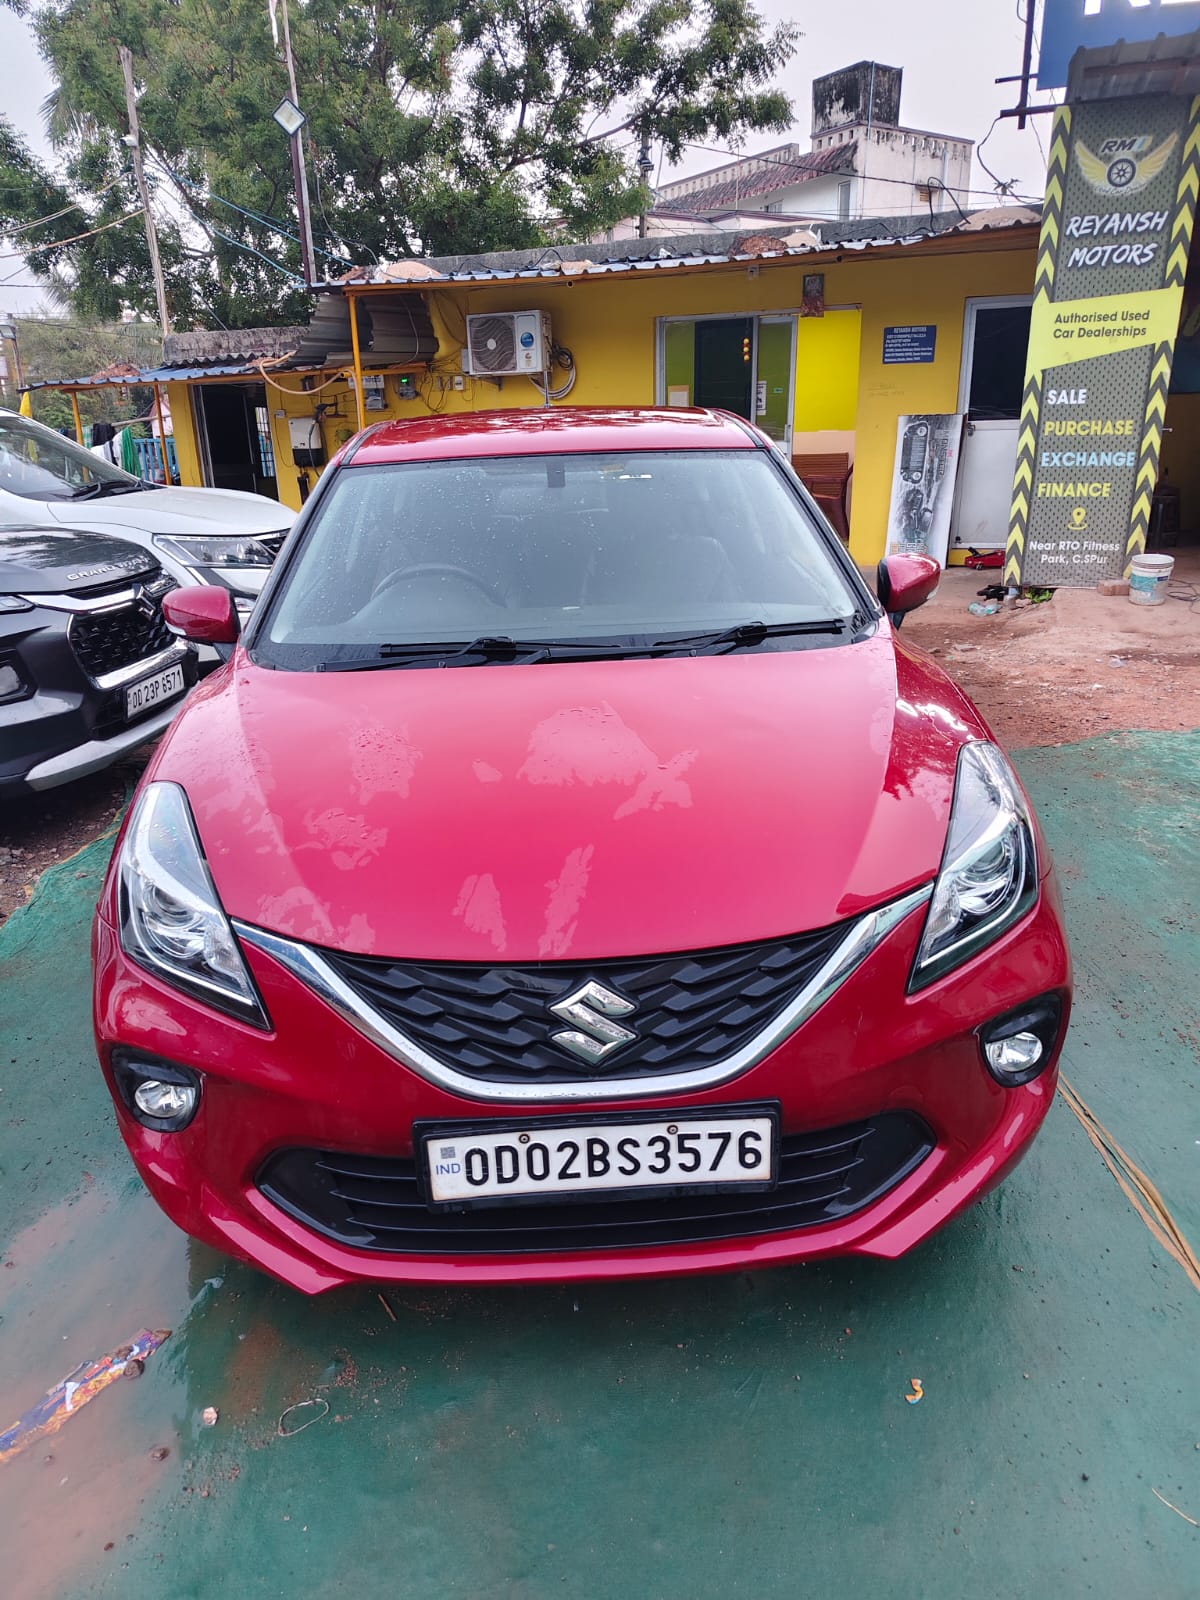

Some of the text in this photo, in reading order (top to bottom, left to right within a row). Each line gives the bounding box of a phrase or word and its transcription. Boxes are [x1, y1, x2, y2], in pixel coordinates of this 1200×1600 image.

[1065, 210, 1169, 238] REYANSH
[1067, 243, 1158, 268] MOTORS
[1054, 310, 1150, 324] Authorised Used
[1053, 325, 1147, 339] Car Dealerships
[1047, 388, 1088, 405] SALE
[1044, 420, 1134, 436] PURCHASE
[1041, 451, 1136, 467] EXCHANGE
[1037, 482, 1111, 497] FINANCE
[1029, 540, 1120, 551] Near RTO Fitness
[1041, 554, 1108, 565] Park, C.SPur
[67, 565, 116, 580] GRAND
[143, 680, 160, 702] 23P
[162, 669, 182, 693] 6571
[464, 1130, 762, 1186] OD02BS3576
[435, 1162, 461, 1175] IND
